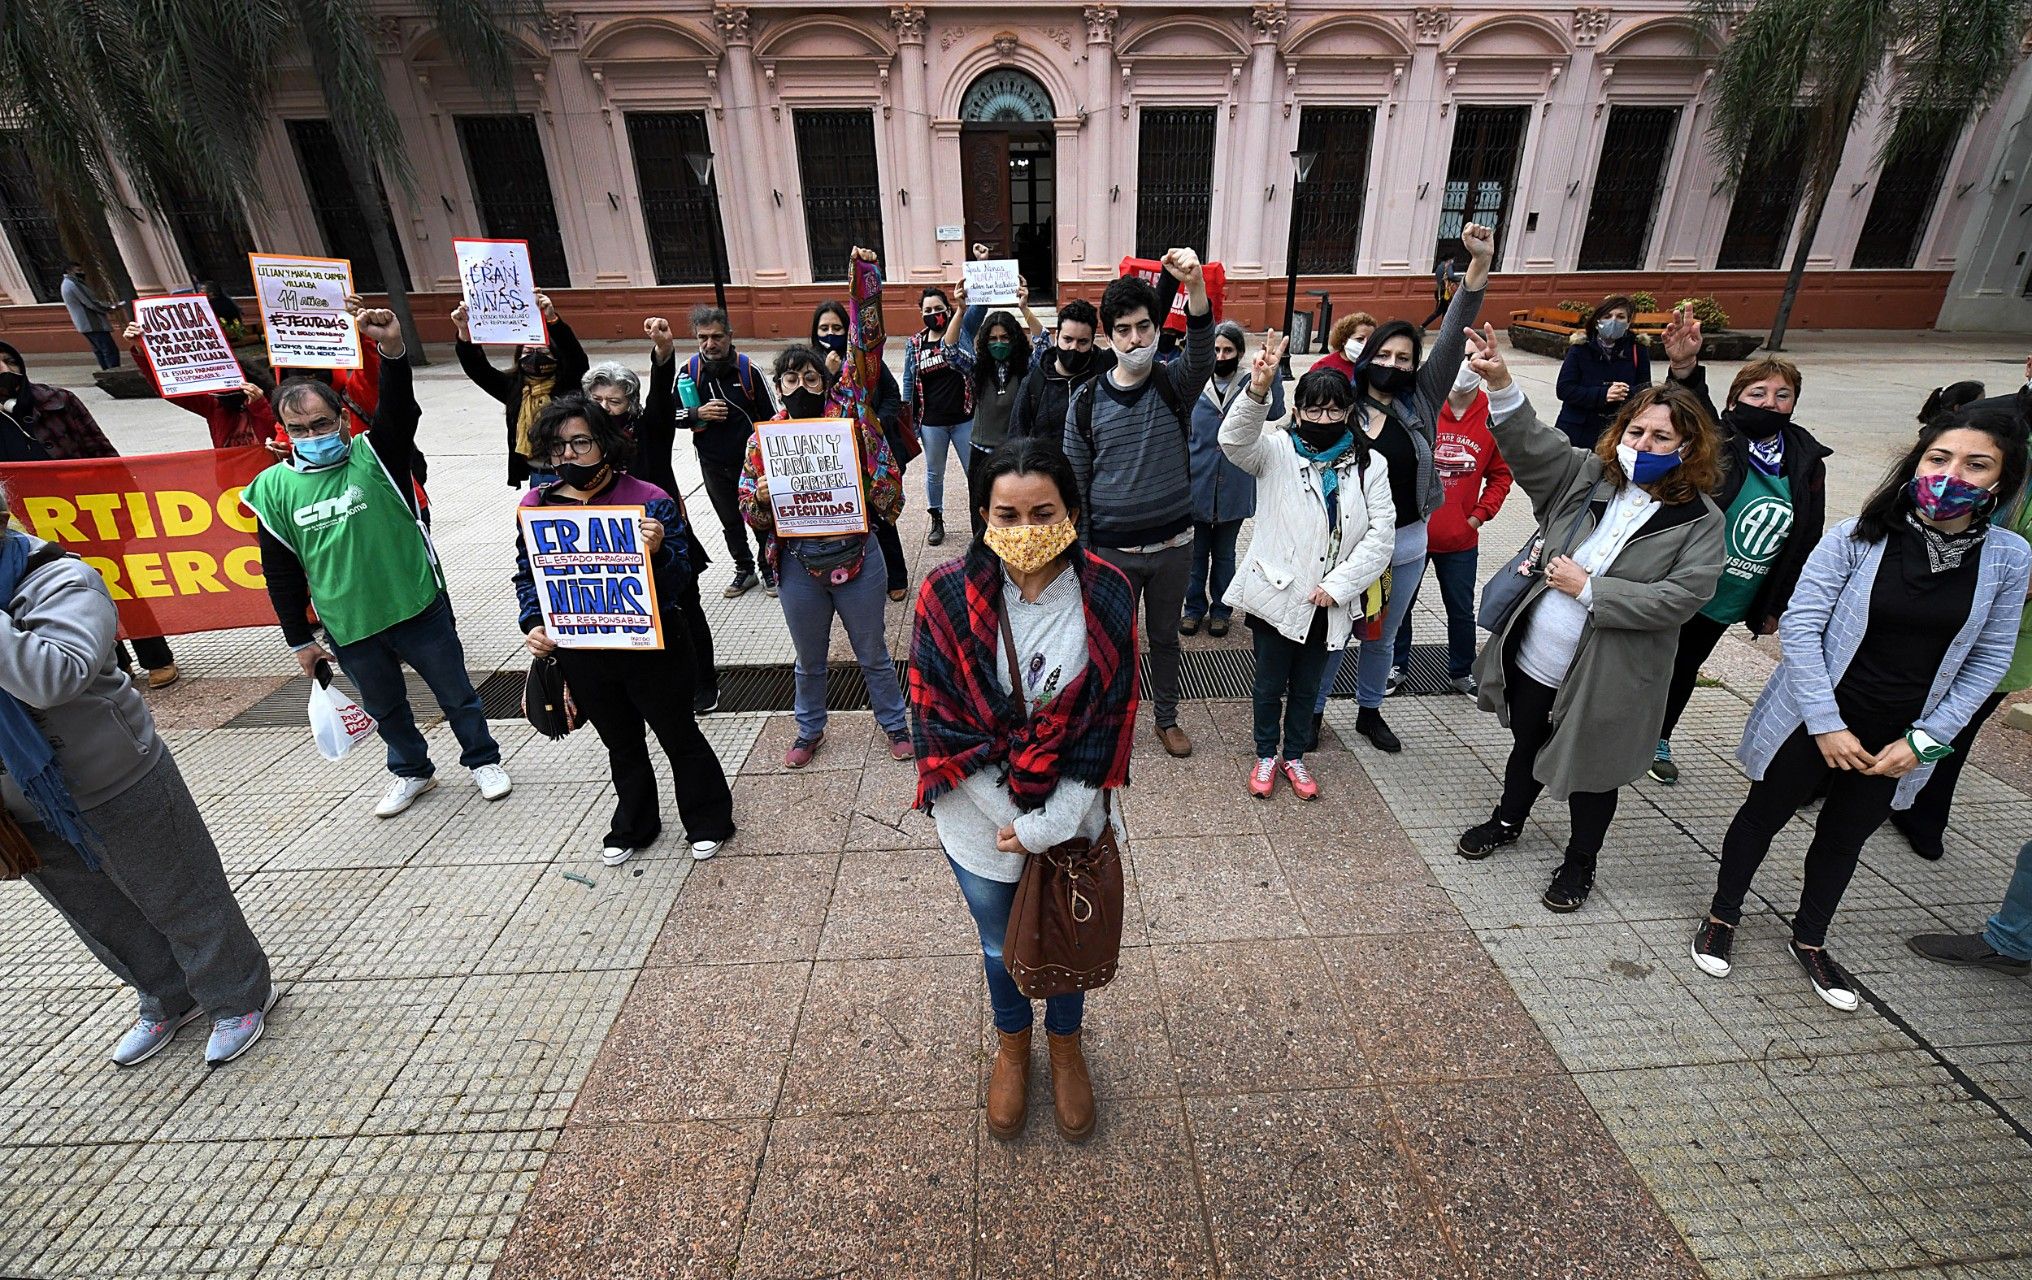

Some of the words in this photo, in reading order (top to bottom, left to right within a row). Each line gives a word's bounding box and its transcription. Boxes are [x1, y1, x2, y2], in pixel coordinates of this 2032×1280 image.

[257, 267, 285, 278] LILIAN
[285, 269, 291, 277] Y
[313, 272, 323, 280] DEL
[283, 280, 317, 289] VILLALBA
[277, 289, 299, 311] 11
[140, 302, 212, 333] JUSTICIA
[145, 333, 172, 345] POR
[173, 328, 218, 342] LILIAN
[150, 346, 162, 357] Y
[206, 340, 225, 350] DEL
[156, 355, 188, 367] CARMEN
[189, 350, 230, 363] VILLALBA
[172, 369, 193, 377] ESTADO
[766, 435, 824, 457] LILIAN
[825, 434, 841, 454] Y
[1456, 437, 1481, 453] GARAGE
[817, 455, 843, 472] DEL
[792, 491, 833, 505] FUERON
[778, 501, 855, 518] EJECUTADAS
[1740, 502, 1793, 555] ATE
[530, 517, 640, 576] ERAN
[538, 555, 552, 565] EL
[555, 554, 593, 564] ESTADO
[595, 554, 641, 563] PARAGUAYO
[1726, 555, 1771, 575] ISIONES
[546, 576, 649, 635] NIÑAS
[557, 615, 571, 624] ES
[576, 615, 648, 625] RESPONSABLE
